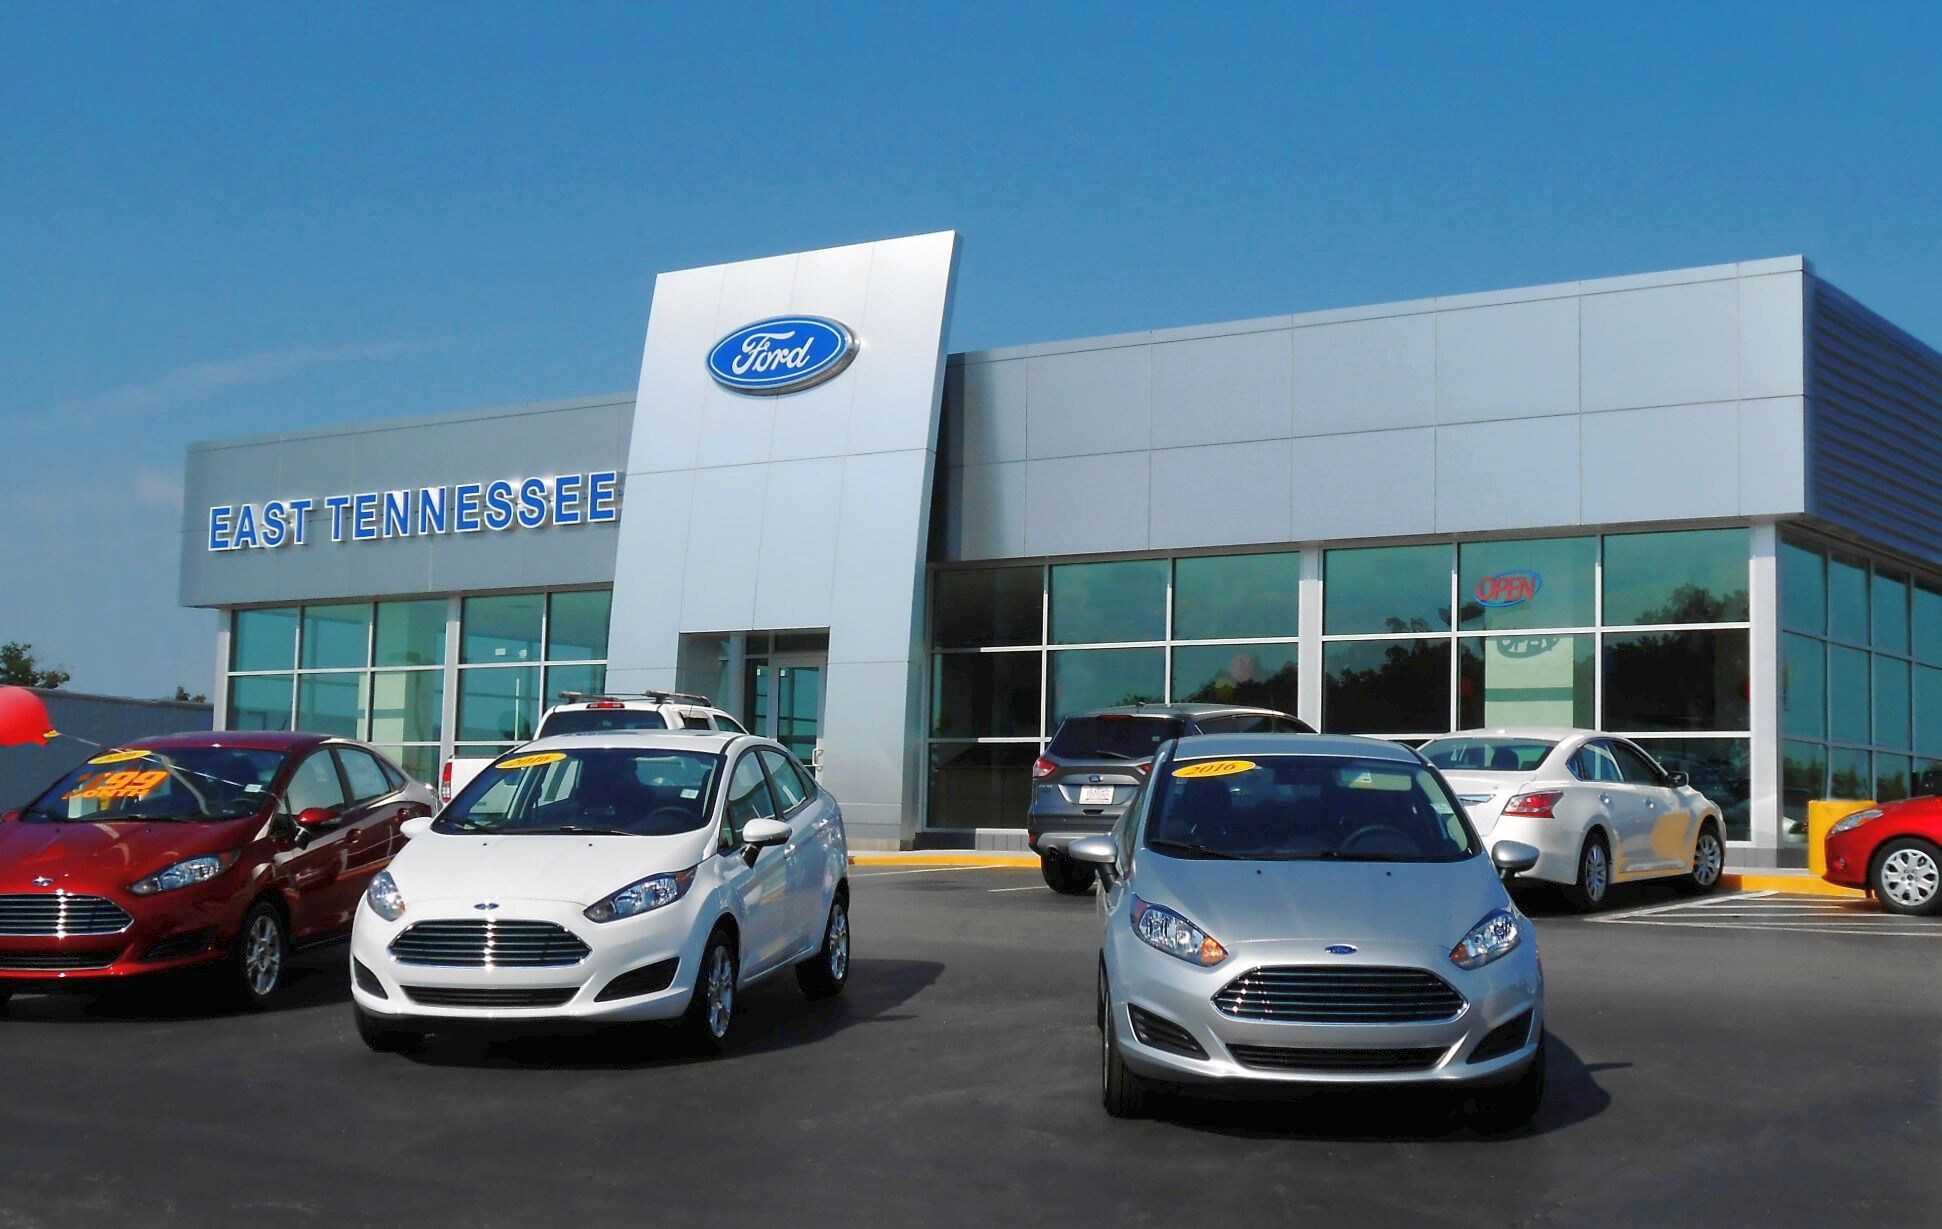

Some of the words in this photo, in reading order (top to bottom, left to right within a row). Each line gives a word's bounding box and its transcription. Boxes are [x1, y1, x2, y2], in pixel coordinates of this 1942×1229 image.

[732, 331, 815, 375] Ford
[208, 499, 313, 551] EAST
[325, 470, 619, 543] TENNESSEE
[1476, 575, 1536, 602] OPEN
[1184, 761, 1238, 776] 2016
